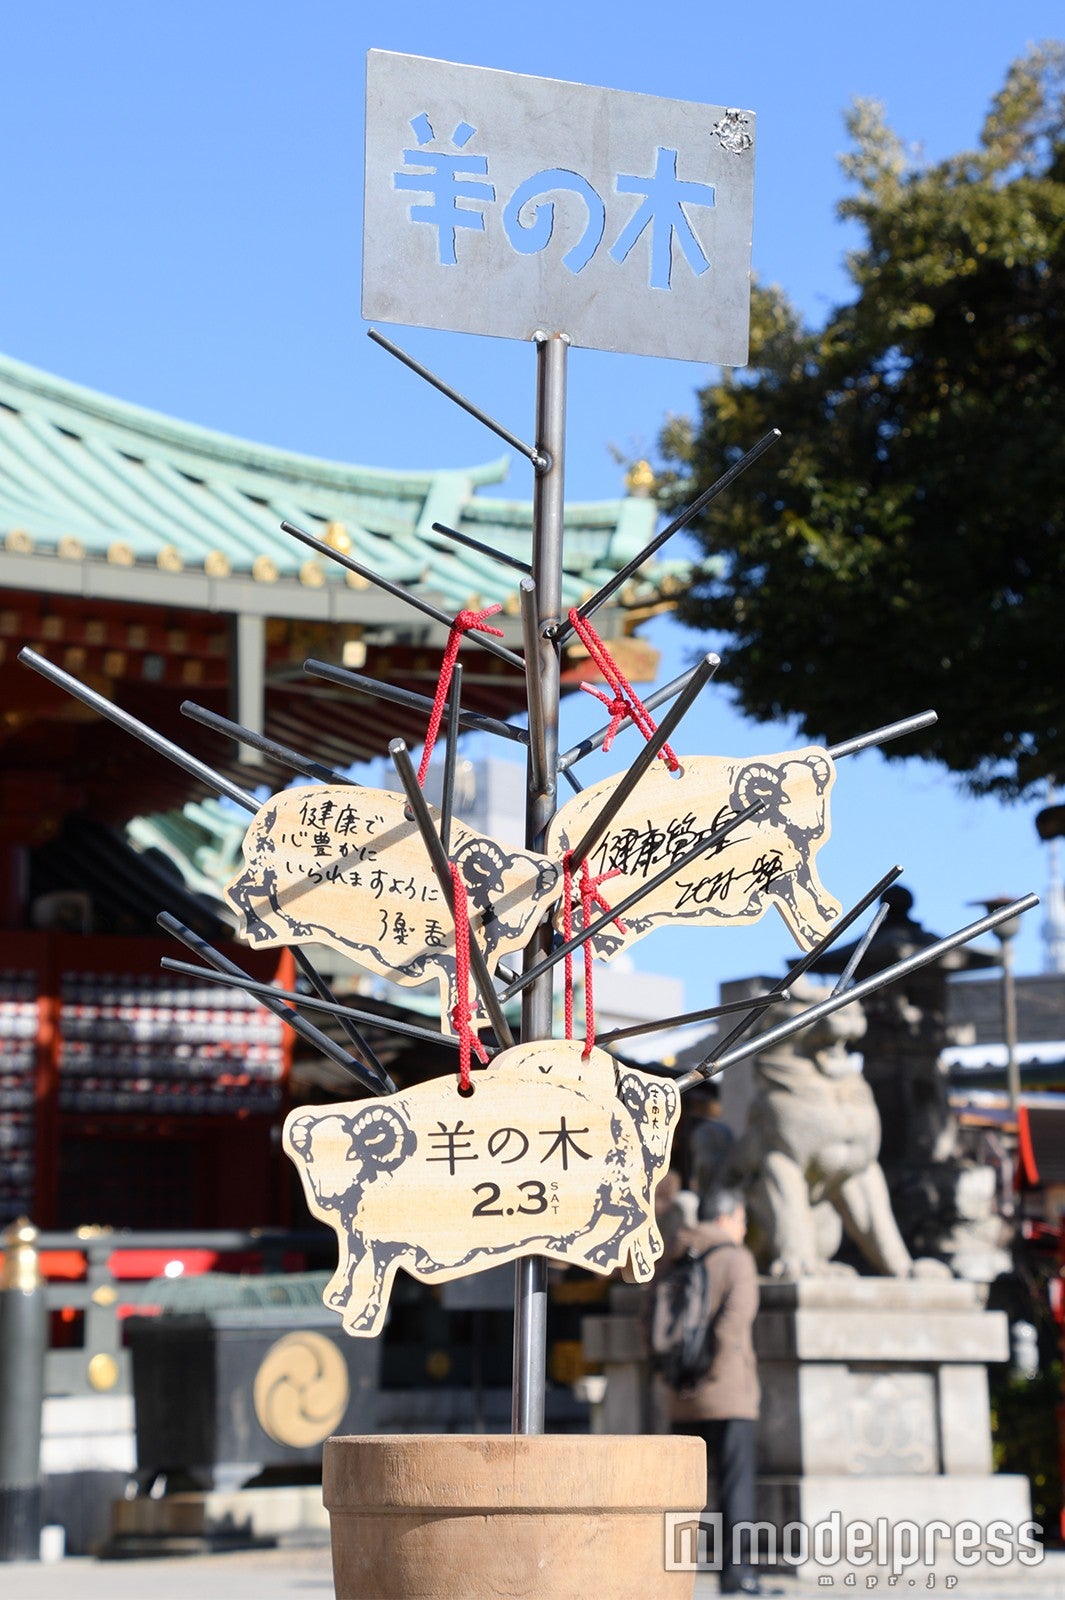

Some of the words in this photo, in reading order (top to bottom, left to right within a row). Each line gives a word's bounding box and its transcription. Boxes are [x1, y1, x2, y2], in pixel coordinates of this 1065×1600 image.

[394, 111, 715, 290] 羊の木
[299, 799, 384, 834] 健康で
[281, 832, 377, 862] 心豊かに
[285, 860, 439, 902] いられますように
[425, 1115, 593, 1176] 羊の木
[471, 1180, 549, 1218] 2.3
[550, 1181, 560, 1215] SAT
